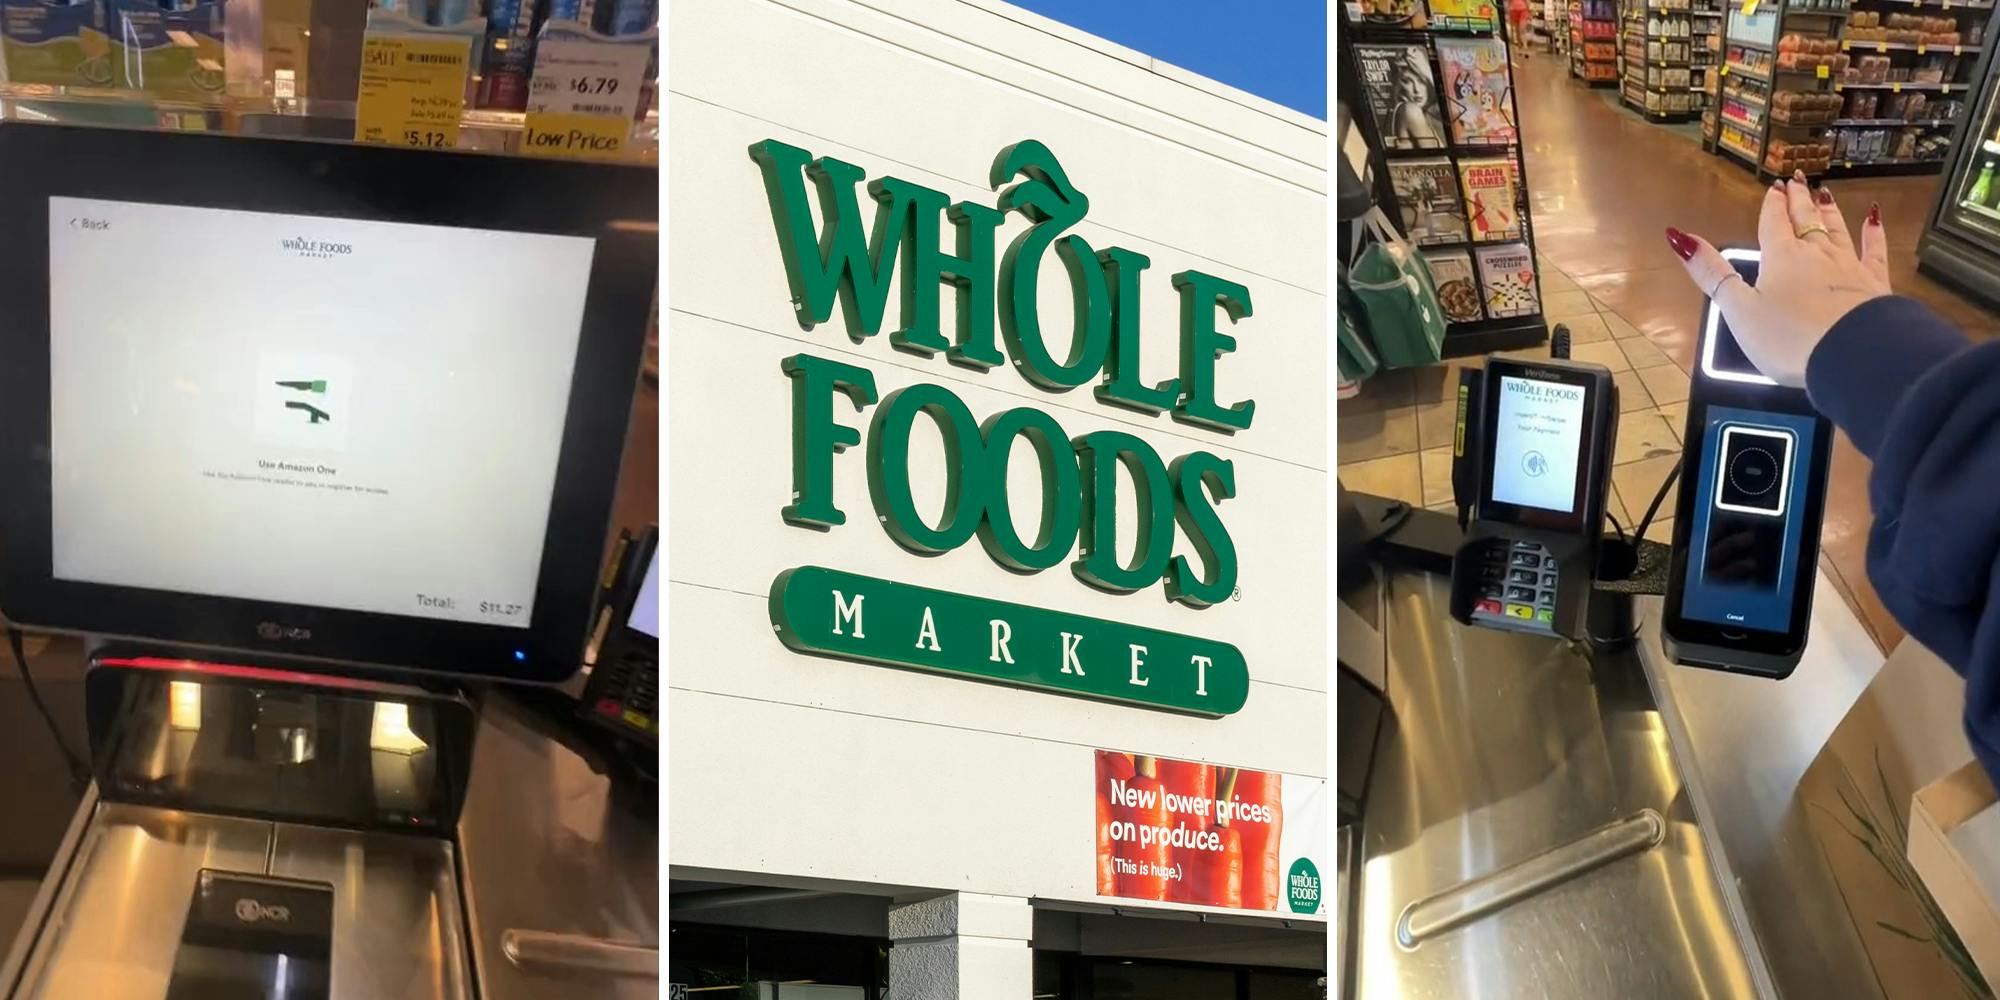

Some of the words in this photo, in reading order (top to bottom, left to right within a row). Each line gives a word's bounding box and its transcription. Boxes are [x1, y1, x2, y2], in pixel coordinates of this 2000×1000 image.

[1361, 59, 1391, 72] TAYLOR
[1366, 70, 1390, 82] SWIFT
[571, 77, 619, 95] $6.79
[404, 130, 445, 148] $5.12
[526, 128, 565, 146] Low
[567, 129, 619, 150] Price
[1391, 168, 1452, 178] MAGNOLIA
[1469, 167, 1504, 178] BRAIN
[1468, 177, 1507, 187] GAMES
[82, 217, 111, 230] Back
[281, 236, 318, 251] WHOLE
[319, 241, 352, 254] FOODS
[1485, 255, 1528, 265] CROSSWORD
[1493, 260, 1522, 269] PUZZLES
[748, 138, 1256, 434] WHOLE
[1506, 380, 1543, 396] WHOLE
[1545, 386, 1580, 400] FOODS
[258, 459, 277, 469] Use
[277, 462, 316, 474] Amazon
[316, 465, 337, 476] One
[781, 353, 1239, 611] FOODS
[416, 592, 456, 609] Total:
[832, 589, 1213, 697] MARKET
[1110, 777, 1157, 810] New
[1159, 784, 1212, 817] lower
[1215, 793, 1273, 824] prices
[1109, 820, 1137, 842] on
[1139, 821, 1225, 852] produce.
[1110, 857, 1137, 875] (This
[1139, 860, 1149, 876] is
[1150, 861, 1183, 882] huge.)
[1290, 869, 1319, 889] WHOLE
[1291, 887, 1319, 901] FOODS
